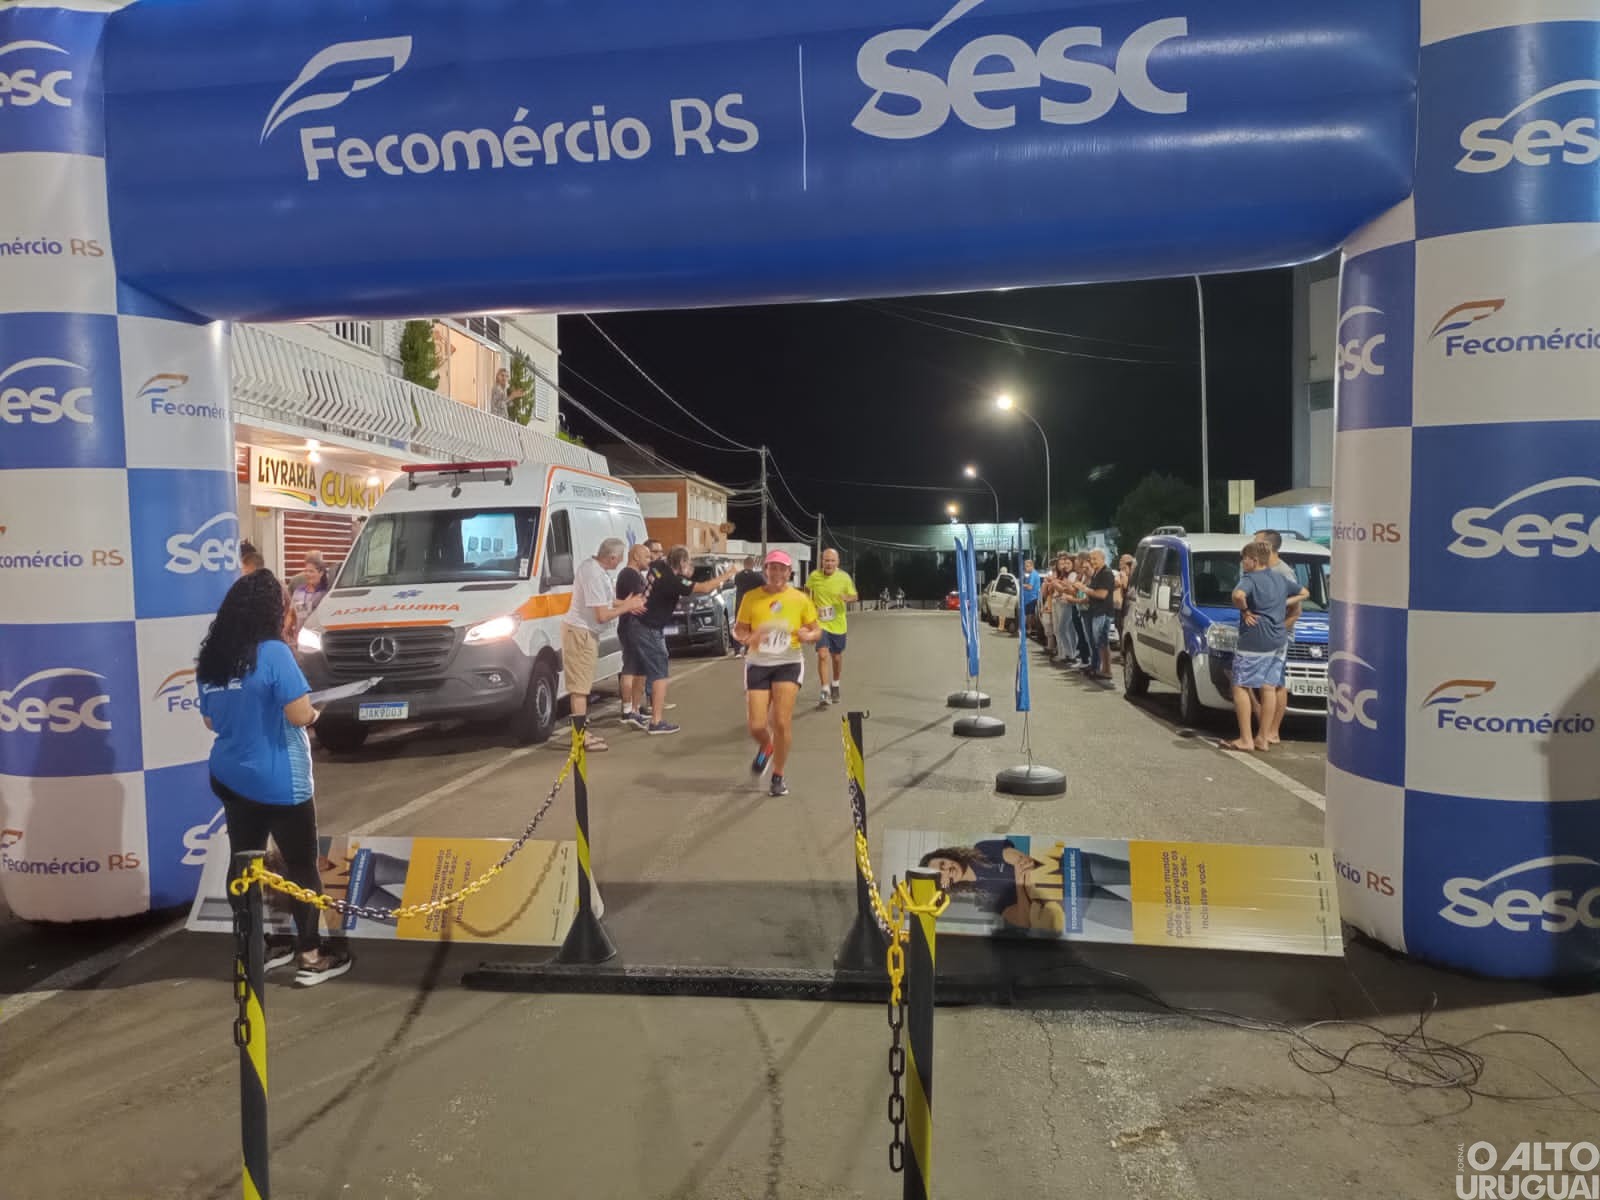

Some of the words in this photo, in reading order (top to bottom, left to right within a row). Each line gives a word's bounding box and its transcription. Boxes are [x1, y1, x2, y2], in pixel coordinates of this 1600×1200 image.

[851, 0, 1189, 139] Sesc
[301, 105, 651, 181] Fecomércio
[671, 94, 760, 157] RS
[70, 238, 104, 256] RS
[0, 386, 94, 424] esc
[164, 511, 243, 574] Ses
[1372, 523, 1401, 543] RS
[91, 549, 125, 566] RS
[1437, 709, 1595, 734] Fecomércio
[108, 852, 140, 871] RS
[1367, 871, 1395, 897] RS
